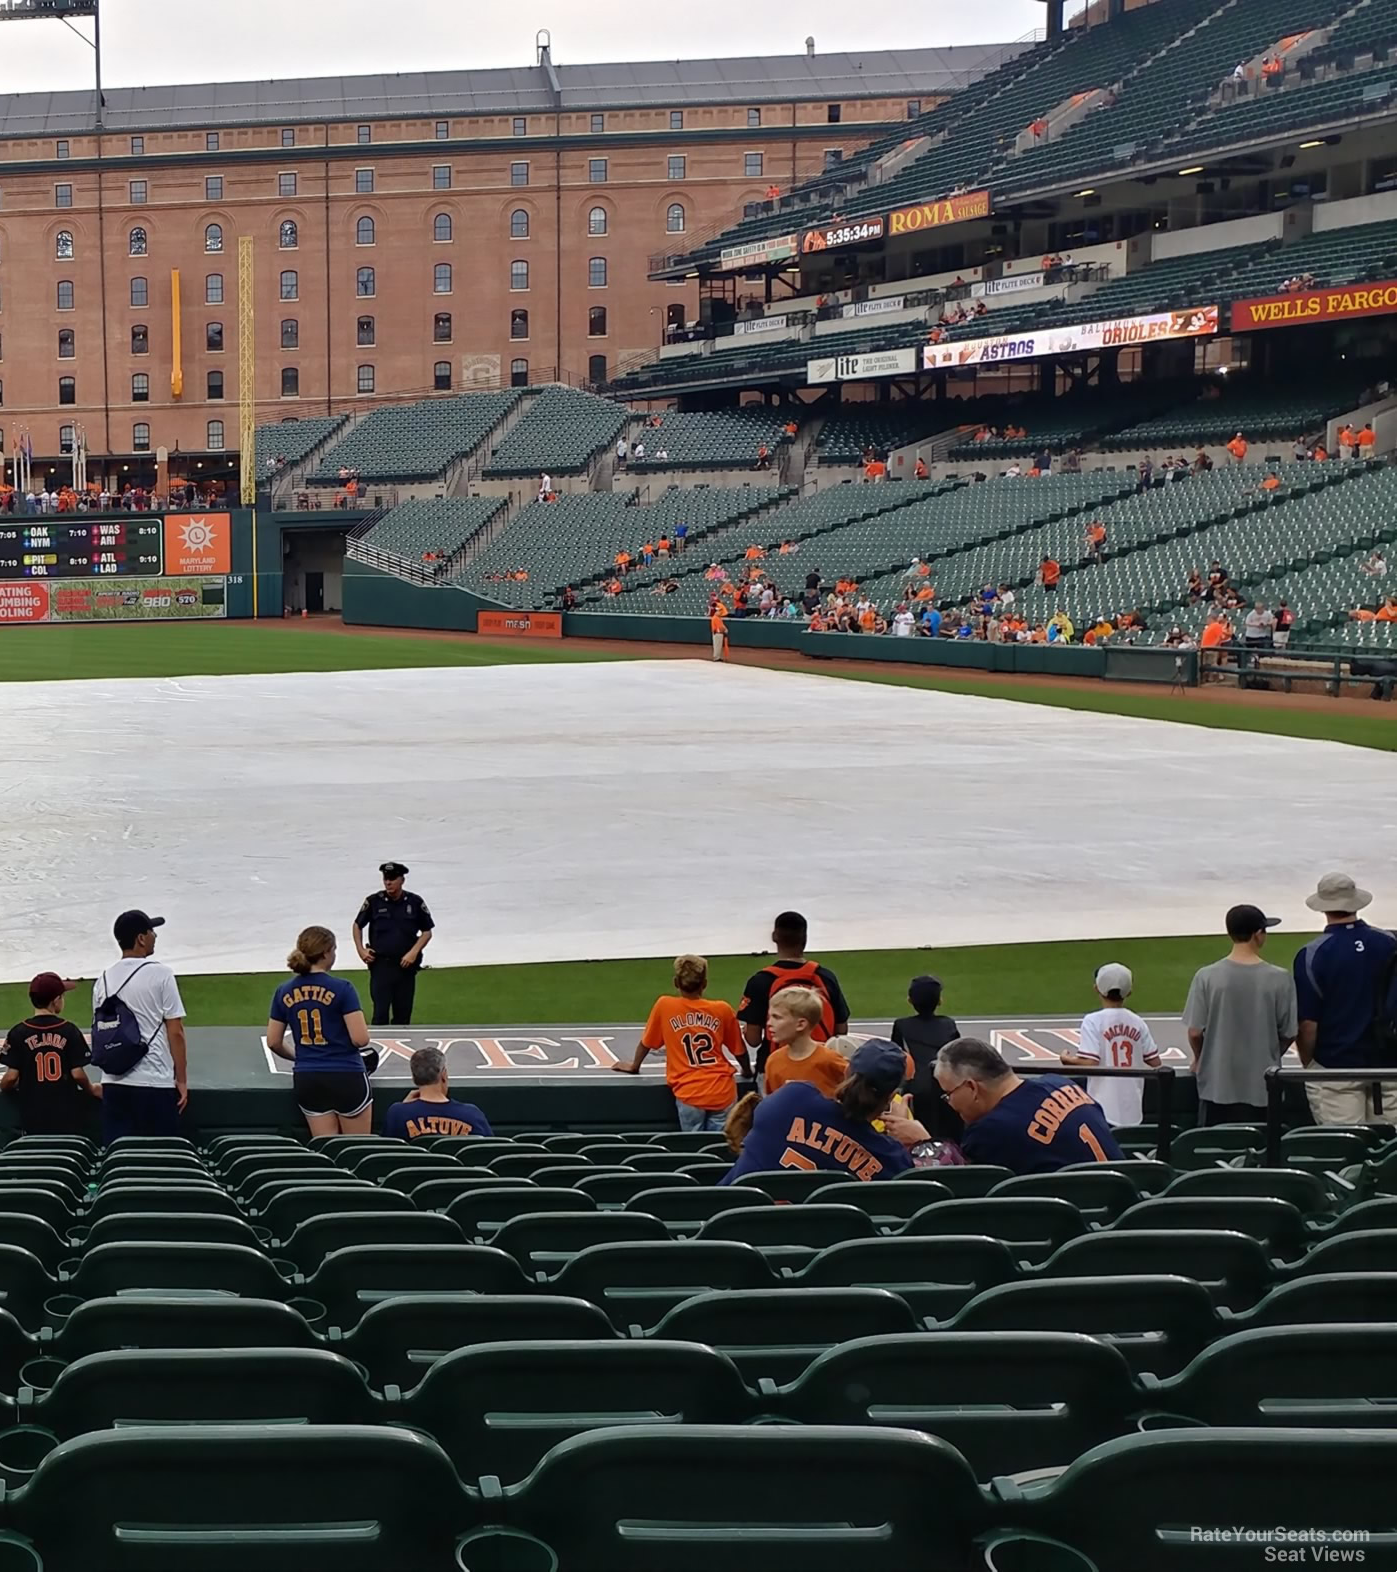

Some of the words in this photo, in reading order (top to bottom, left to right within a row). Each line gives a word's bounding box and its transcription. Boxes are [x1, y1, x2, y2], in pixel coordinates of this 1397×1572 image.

[890, 201, 955, 234] ROMA
[1019, 277, 1036, 287] DECK
[1249, 297, 1321, 322] WELLS
[1326, 286, 1397, 313] FARGO
[1102, 320, 1169, 345] ORIOLES
[980, 339, 1035, 361] ASTROS
[862, 357, 874, 366] THE
[873, 355, 898, 364] ORIGINAL
[30, 527, 48, 537] OAK
[69, 529, 87, 537] 7:10
[100, 525, 120, 535] WAS
[139, 527, 157, 535] 8:10
[30, 538, 50, 548] NYM
[100, 535, 116, 545] ARI
[0, 559, 18, 567] 7:10
[31, 554, 45, 564] PIT
[100, 552, 116, 562] ATL
[179, 557, 216, 565] MARYLAND
[31, 566, 49, 576] COL
[100, 563, 117, 573] LAD
[183, 564, 213, 573] LOTTERY
[227, 576, 243, 584] 318
[143, 596, 171, 608] 980
[178, 595, 196, 604] 570
[1354, 940, 1365, 952] 3
[282, 985, 337, 1009] GATTIS
[297, 1008, 328, 1045] 11
[669, 1012, 720, 1032] ALOMAR
[1103, 1023, 1142, 1042] MACHADO
[24, 1032, 67, 1051] TEJADA
[681, 1032, 717, 1068] 12
[1111, 1040, 1133, 1068] 13
[35, 1051, 63, 1082] 10
[406, 1116, 473, 1138] ALTUVE
[1079, 1123, 1108, 1162] 1
[786, 1116, 884, 1182] ALTUVE
